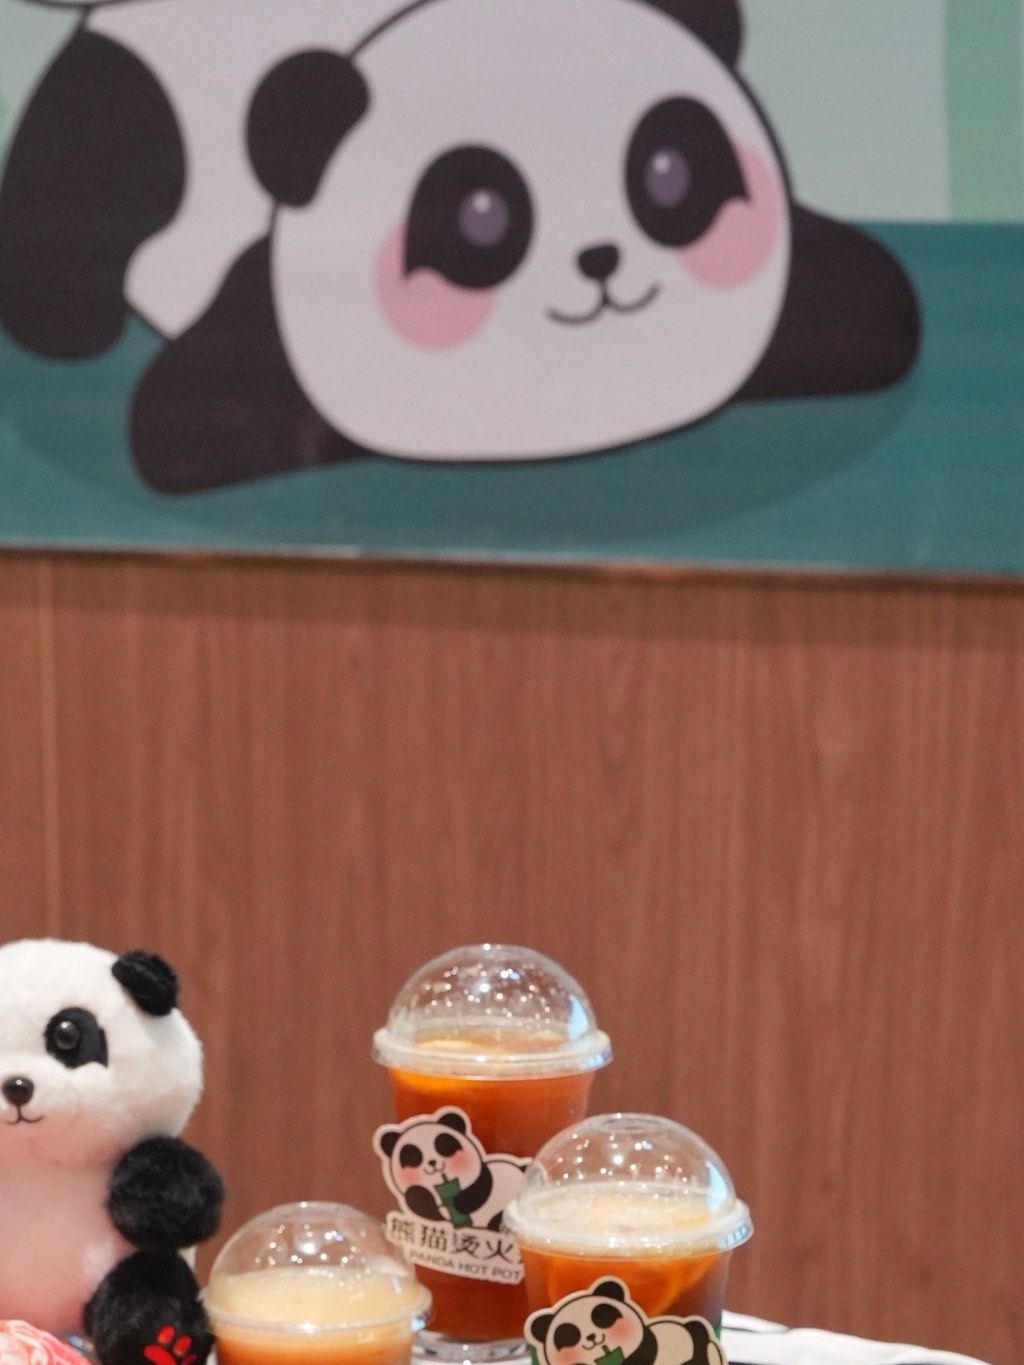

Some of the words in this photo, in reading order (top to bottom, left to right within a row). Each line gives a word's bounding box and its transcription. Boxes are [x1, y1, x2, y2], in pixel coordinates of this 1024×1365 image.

[392, 1218, 523, 1264] 熊猫烫火
[409, 1250, 454, 1268] PANDA
[459, 1263, 487, 1275] HOT
[492, 1268, 521, 1279] POT
